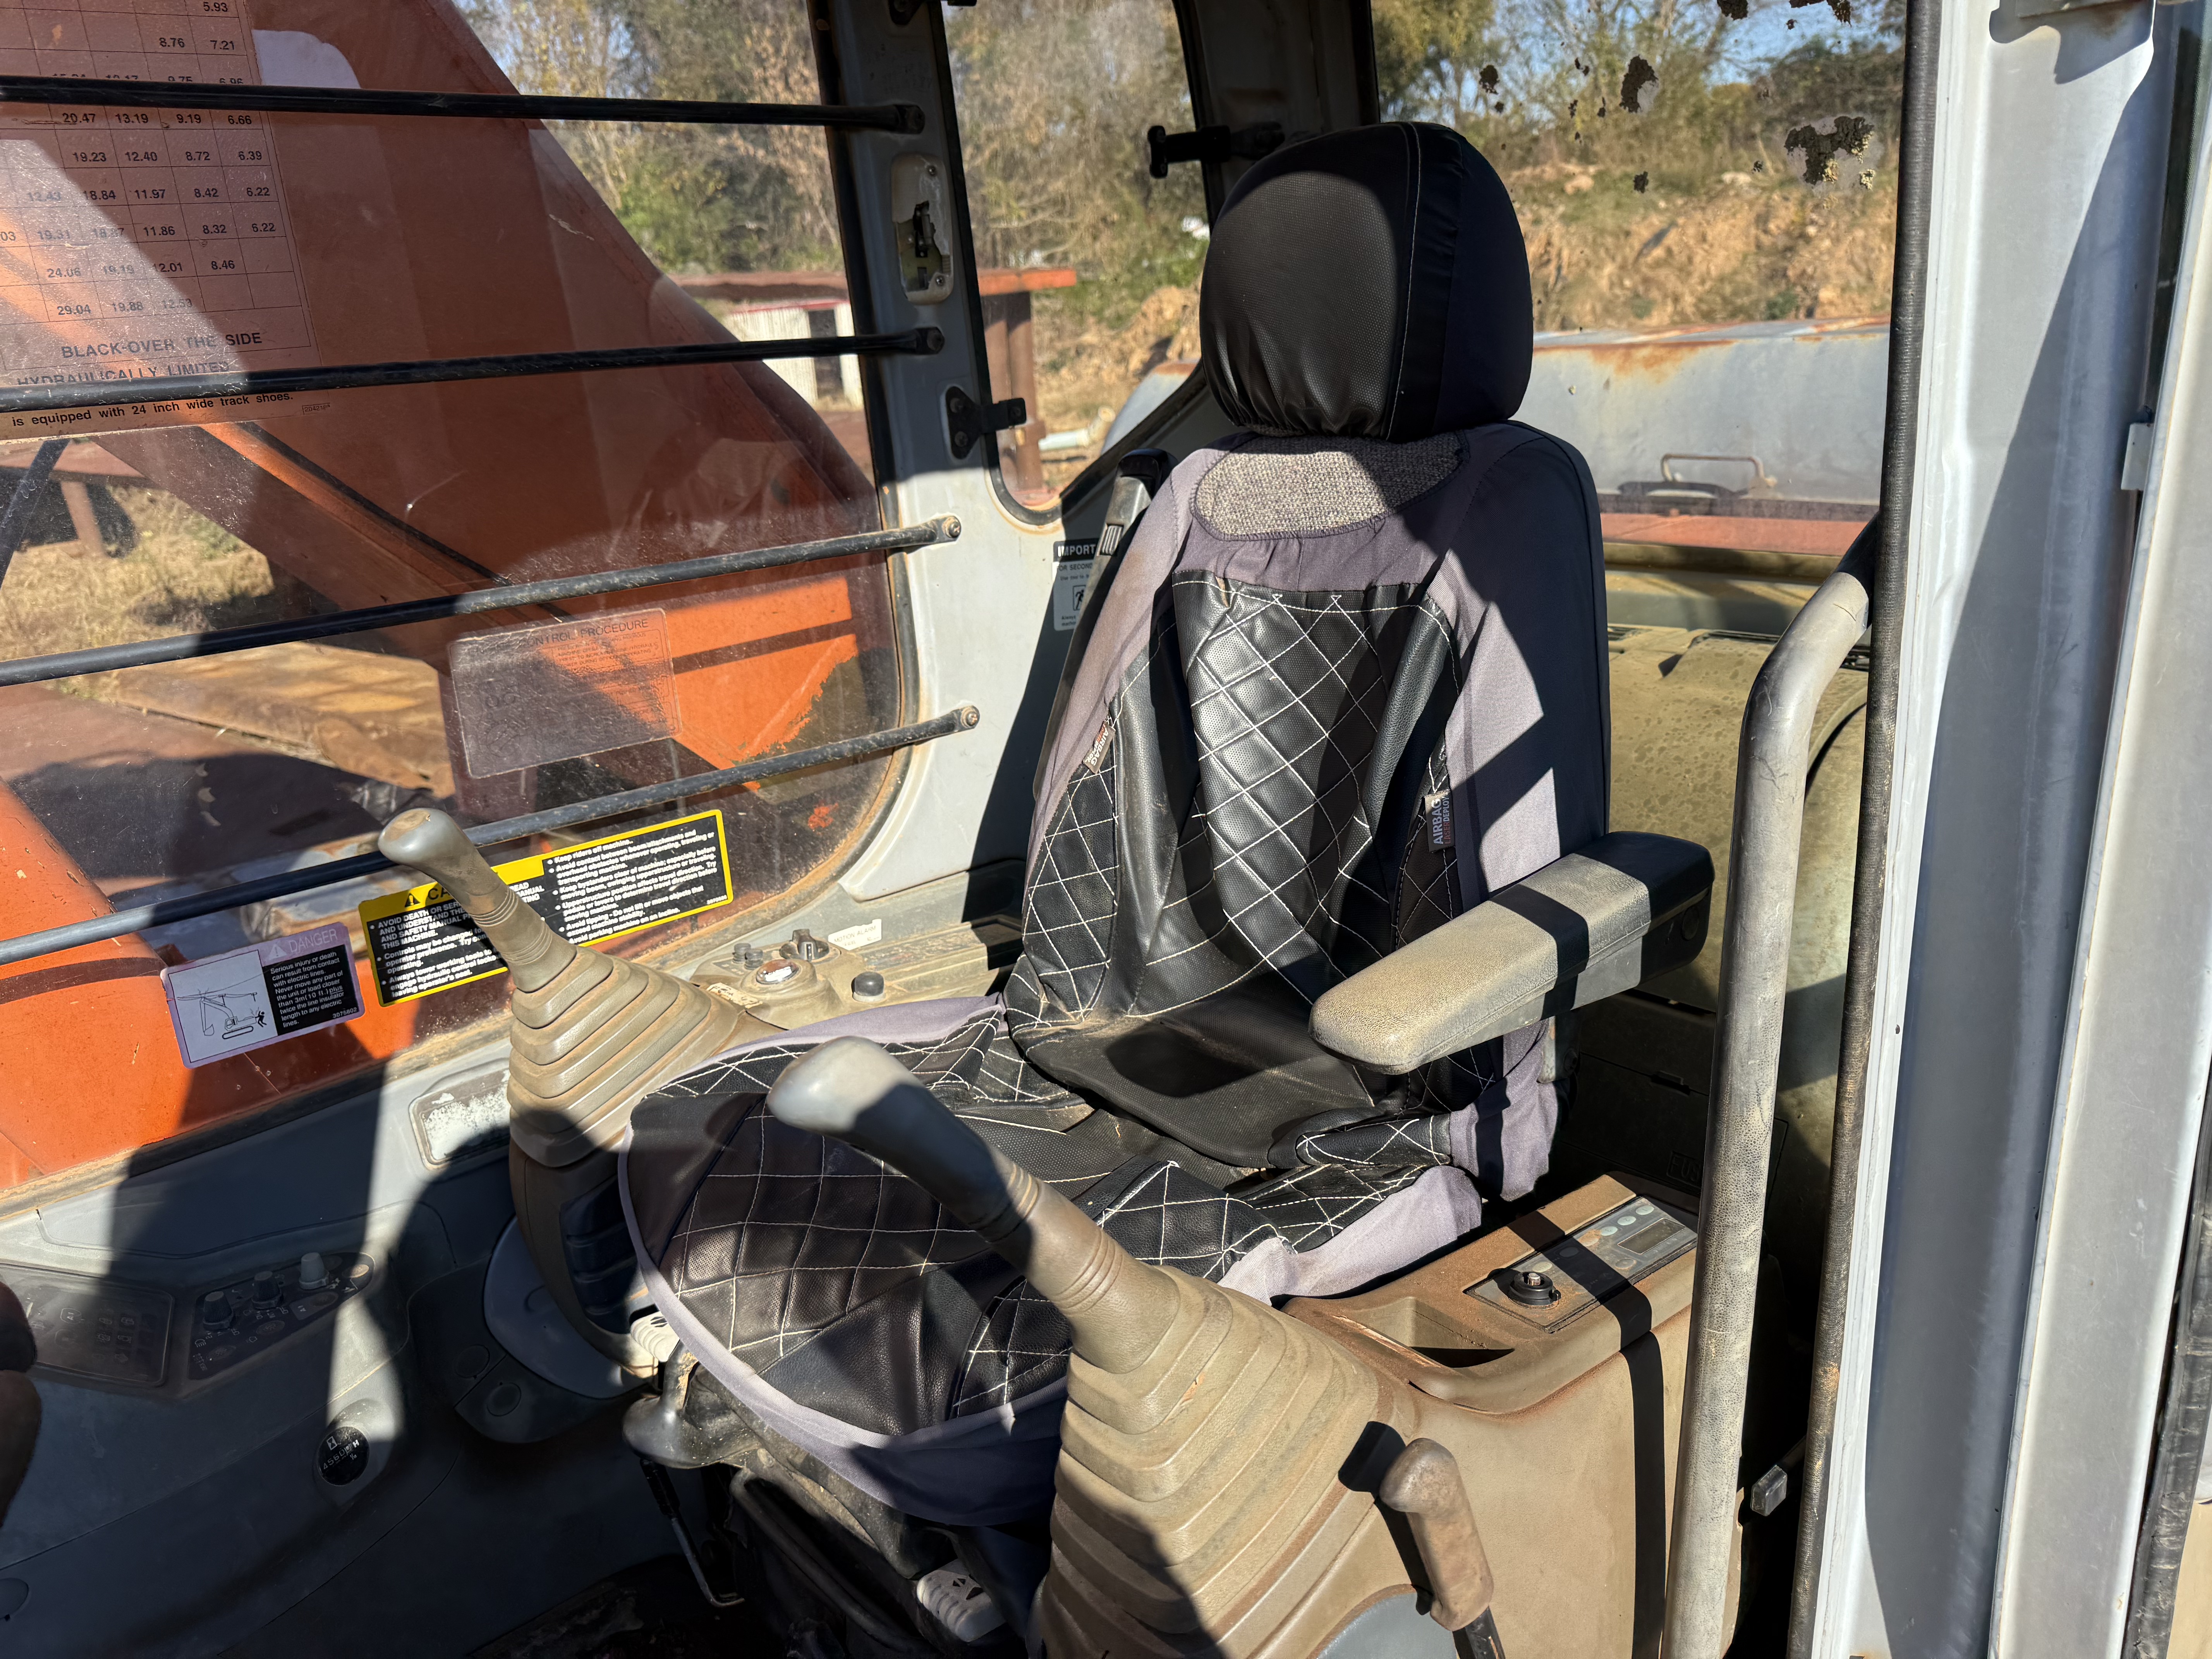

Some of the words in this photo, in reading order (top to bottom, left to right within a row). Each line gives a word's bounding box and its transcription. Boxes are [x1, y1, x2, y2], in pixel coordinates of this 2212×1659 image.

[203, 2, 228, 12] 5.93
[159, 38, 185, 48] 8.76
[210, 40, 234, 50] 7.21
[62, 113, 96, 123] 20.47
[115, 113, 148, 123] 13.19
[176, 114, 201, 124] 9.19
[228, 115, 252, 124] 6.66
[73, 152, 106, 162] 19.23
[125, 151, 158, 161] 12.40
[185, 151, 210, 161] 8.72
[238, 151, 262, 160] 6.39
[83, 190, 116, 200] 18.84
[135, 189, 166, 199] 11.97
[194, 188, 219, 198] 8.42
[246, 187, 270, 196] 6.22
[143, 226, 175, 236] 11.86
[203, 225, 227, 234] 8.32
[252, 223, 276, 232] 6.22
[153, 262, 183, 272] 12.01
[211, 260, 235, 270] 8.46
[57, 304, 91, 315] 29.04
[112, 301, 144, 312] 19.88
[62, 338, 174, 359] BLACK-OVER
[184, 336, 217, 349] THE
[225, 332, 263, 345] SIDE
[168, 362, 230, 376] LIMITED
[12, 417, 24, 426] is
[32, 410, 91, 425] equipped
[99, 407, 125, 418] with
[132, 404, 146, 415] 24
[153, 402, 179, 413] inch
[186, 399, 214, 409] wide
[220, 395, 249, 406] track
[256, 393, 294, 403] shoes.
[1058, 544, 1096, 557] IMPORT
[581, 620, 649, 637] PROCEDURE
[1091, 728, 1109, 766] AIRBAG
[1432, 799, 1444, 844] AIRBAG
[554, 854, 572, 863] Keep
[572, 849, 592, 858] riders
[556, 861, 575, 871] Avoid
[576, 855, 600, 866] contact
[601, 848, 627, 859] between
[684, 829, 696, 837] and
[556, 865, 587, 878] overhead
[588, 858, 619, 870] obstacles
[619, 850, 649, 861] whenever
[681, 834, 707, 845] traveling
[558, 871, 598, 885] transporting
[599, 863, 627, 874] machine.
[559, 884, 577, 893] Keep
[577, 875, 613, 888] bystanders
[666, 852, 696, 864] especially
[696, 847, 715, 855] before
[560, 889, 586, 900] moving
[607, 875, 635, 887] swinging
[636, 863, 680, 879] upperstructure
[562, 891, 610, 908] Upperstructure
[611, 884, 636, 895] position
[637, 878, 658, 887] affects
[658, 871, 676, 881] travel
[676, 865, 704, 876] direction.
[563, 905, 585, 916] pedals
[622, 886, 653, 898] determine
[653, 879, 671, 889] travel
[671, 873, 697, 884] direction
[698, 867, 717, 877] before
[378, 917, 401, 928] AVOID
[404, 910, 429, 921] DEATH
[564, 911, 589, 922] moving
[590, 903, 618, 914] machine.
[566, 919, 585, 930] Avoid
[586, 914, 608, 924] tipping
[651, 896, 668, 905] move
[669, 890, 691, 900] objects
[380, 926, 395, 935] AND
[398, 912, 448, 929] UNDERSTAND
[381, 934, 397, 942] AND
[399, 924, 428, 937] SAFETY
[429, 916, 461, 929] MANUAL
[567, 925, 591, 936] exceed
[591, 918, 618, 929] machine
[588, 927, 613, 939] parking
[613, 919, 639, 931] machine
[658, 908, 680, 917] incline.
[290, 929, 338, 953] DANGER
[382, 940, 399, 949] THIS
[402, 930, 438, 944] MACHINE.
[385, 947, 415, 959] Controls
[416, 942, 431, 950] may
[386, 954, 416, 966] operator
[417, 943, 457, 959] preference.
[270, 964, 293, 974] Serious
[285, 969, 301, 977] result
[318, 958, 339, 967] contact
[388, 960, 423, 973] operating.
[390, 972, 414, 982] Always
[415, 965, 435, 975] lower
[436, 957, 465, 969] working
[287, 974, 309, 983] electric
[322, 979, 339, 988] closer
[391, 979, 416, 989] engage
[275, 986, 292, 994] Never
[319, 992, 343, 1002] insulator
[329, 986, 343, 994] plus
[392, 986, 417, 996] leaving
[281, 1012, 300, 1020] length
[321, 1000, 341, 1009] electric
